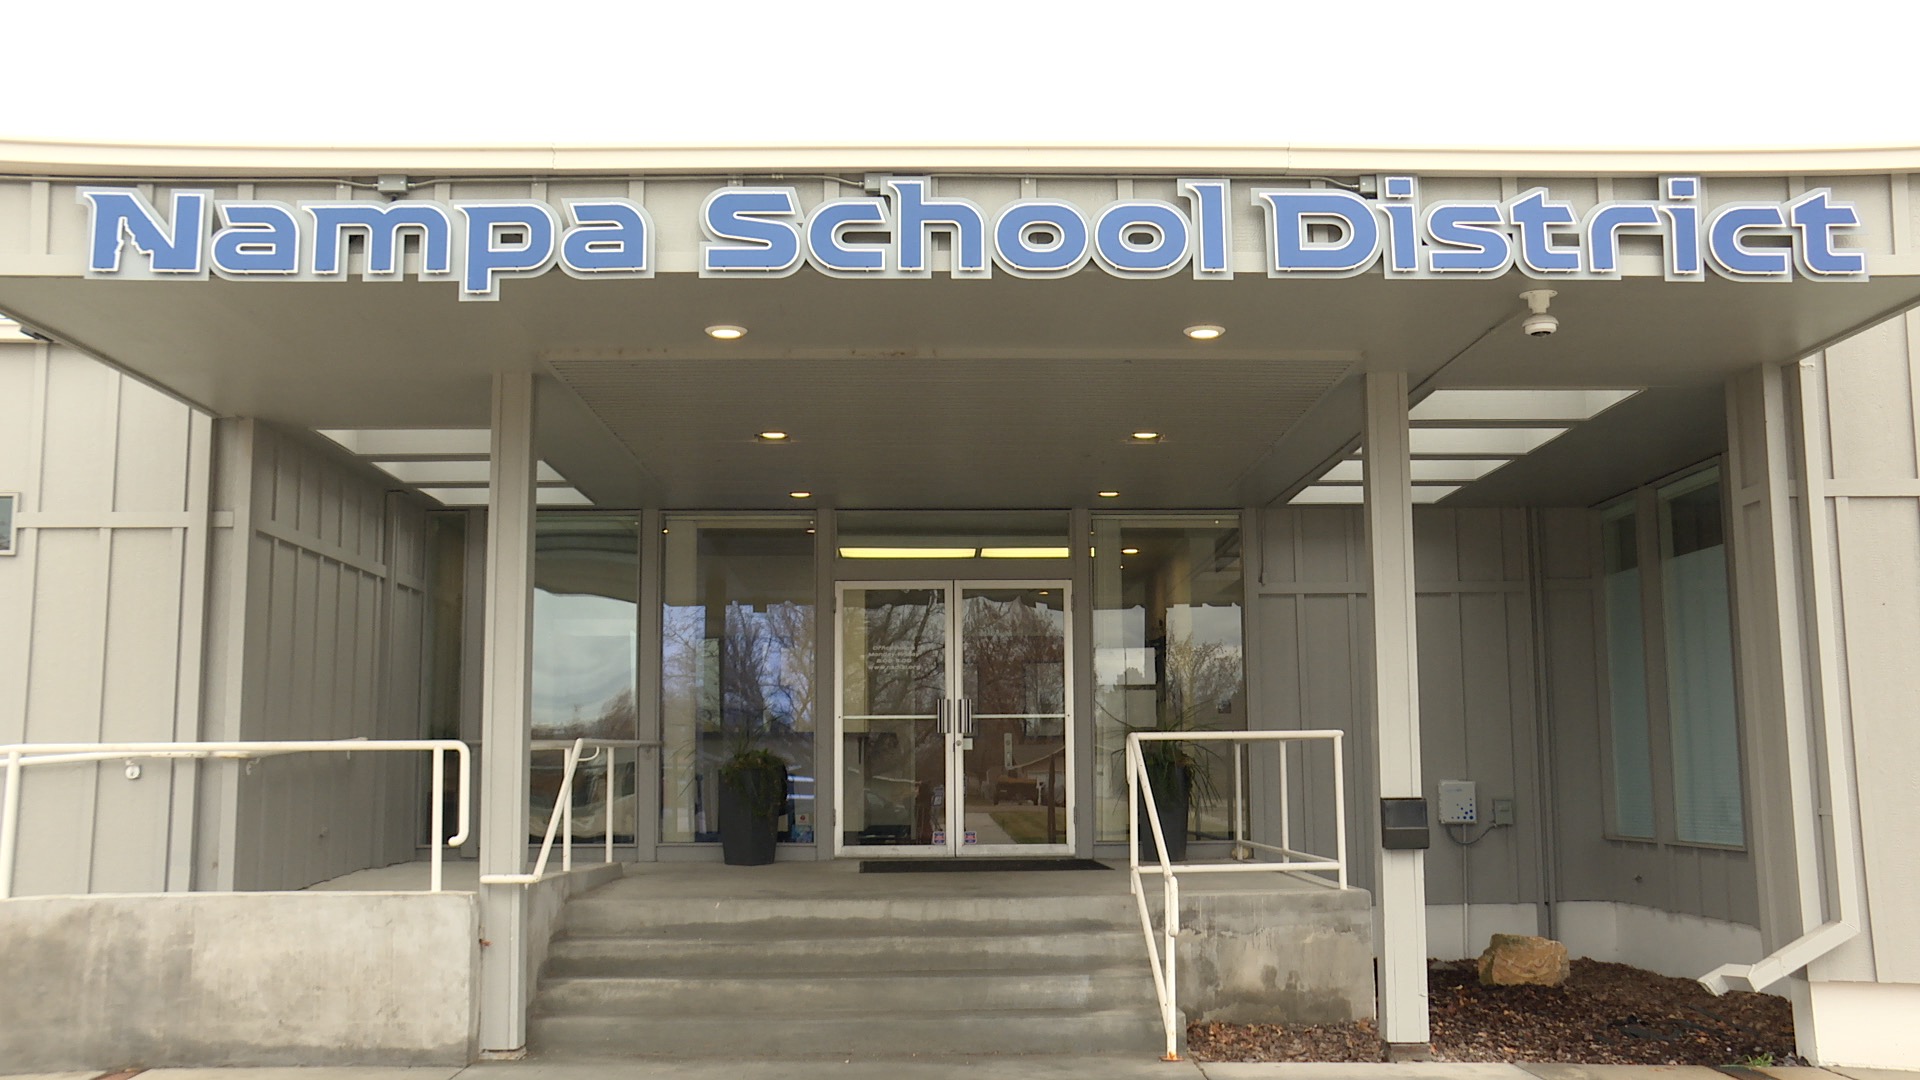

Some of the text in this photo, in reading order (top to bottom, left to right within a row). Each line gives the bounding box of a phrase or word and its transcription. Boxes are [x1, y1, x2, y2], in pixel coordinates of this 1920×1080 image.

[80, 175, 1866, 296] Nampa School District
